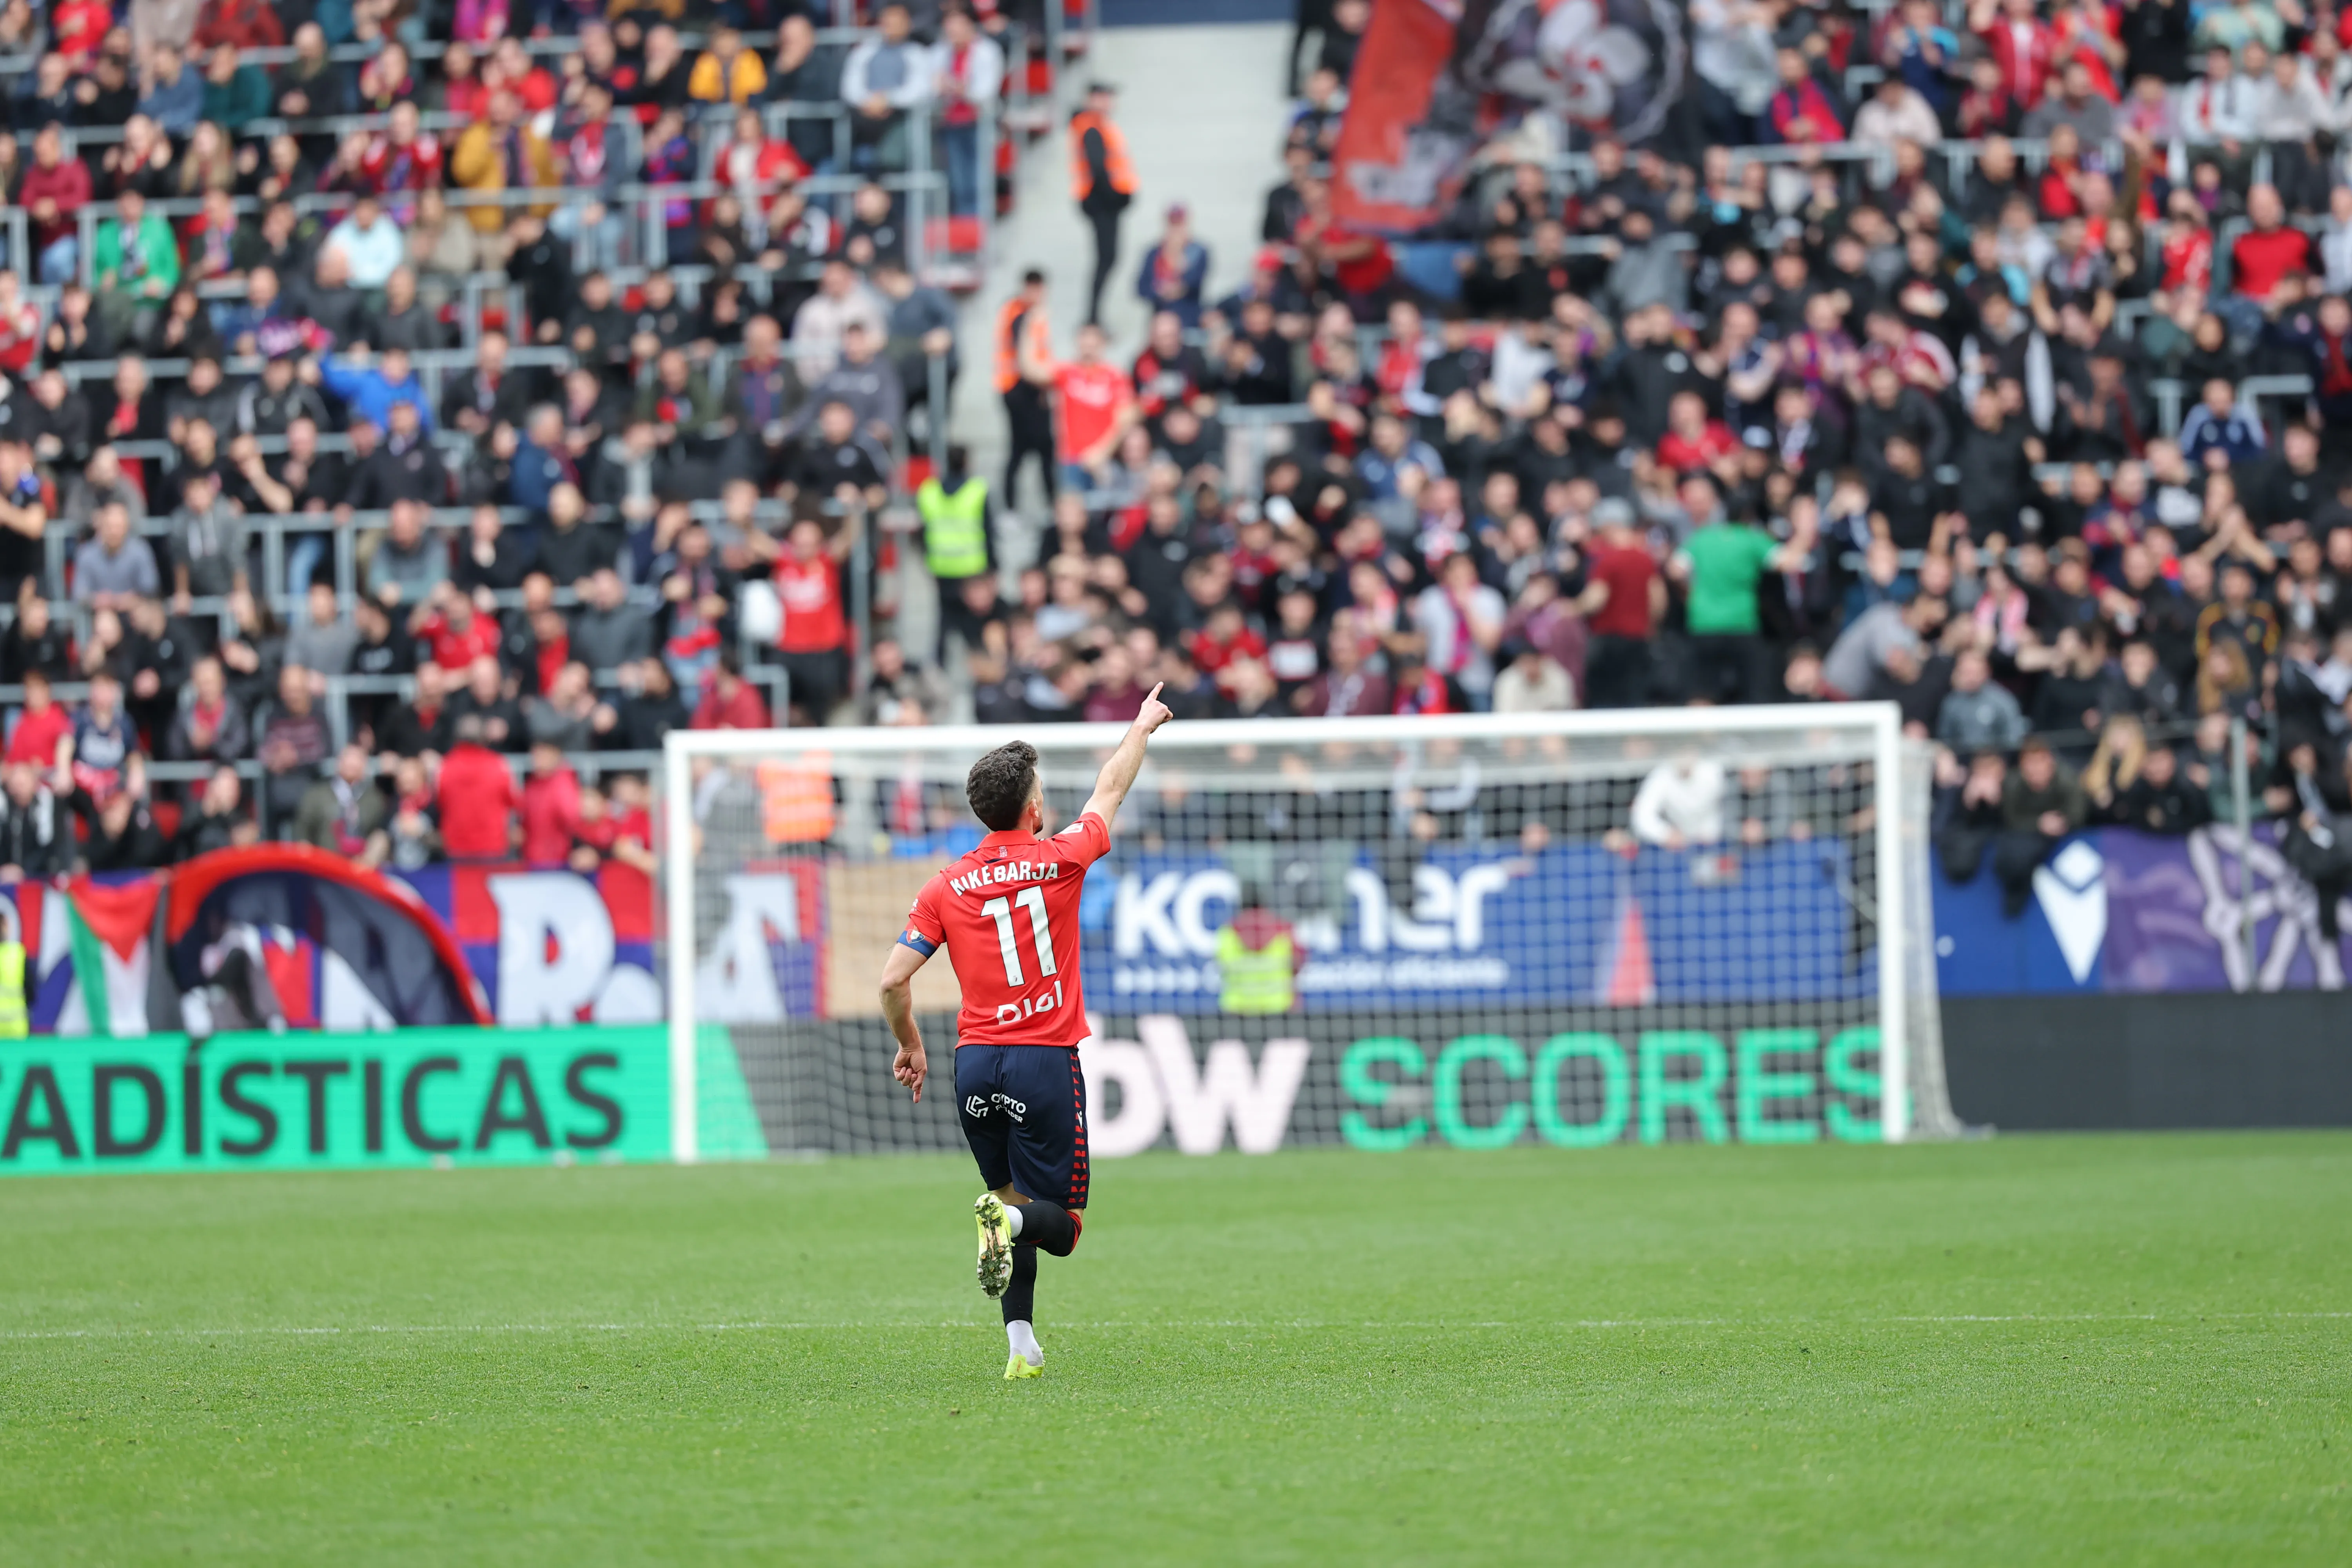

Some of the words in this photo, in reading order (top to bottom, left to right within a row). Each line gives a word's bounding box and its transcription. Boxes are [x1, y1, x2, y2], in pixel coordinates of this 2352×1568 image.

[949, 865, 993, 897] KIKE
[994, 861, 1058, 883] BARJA
[980, 885, 1058, 987] 11
[996, 980, 1063, 1025] DIGI
[0, 1038, 624, 1159] ADÍSTICAS
[1340, 1026, 1914, 1152] SCORES
